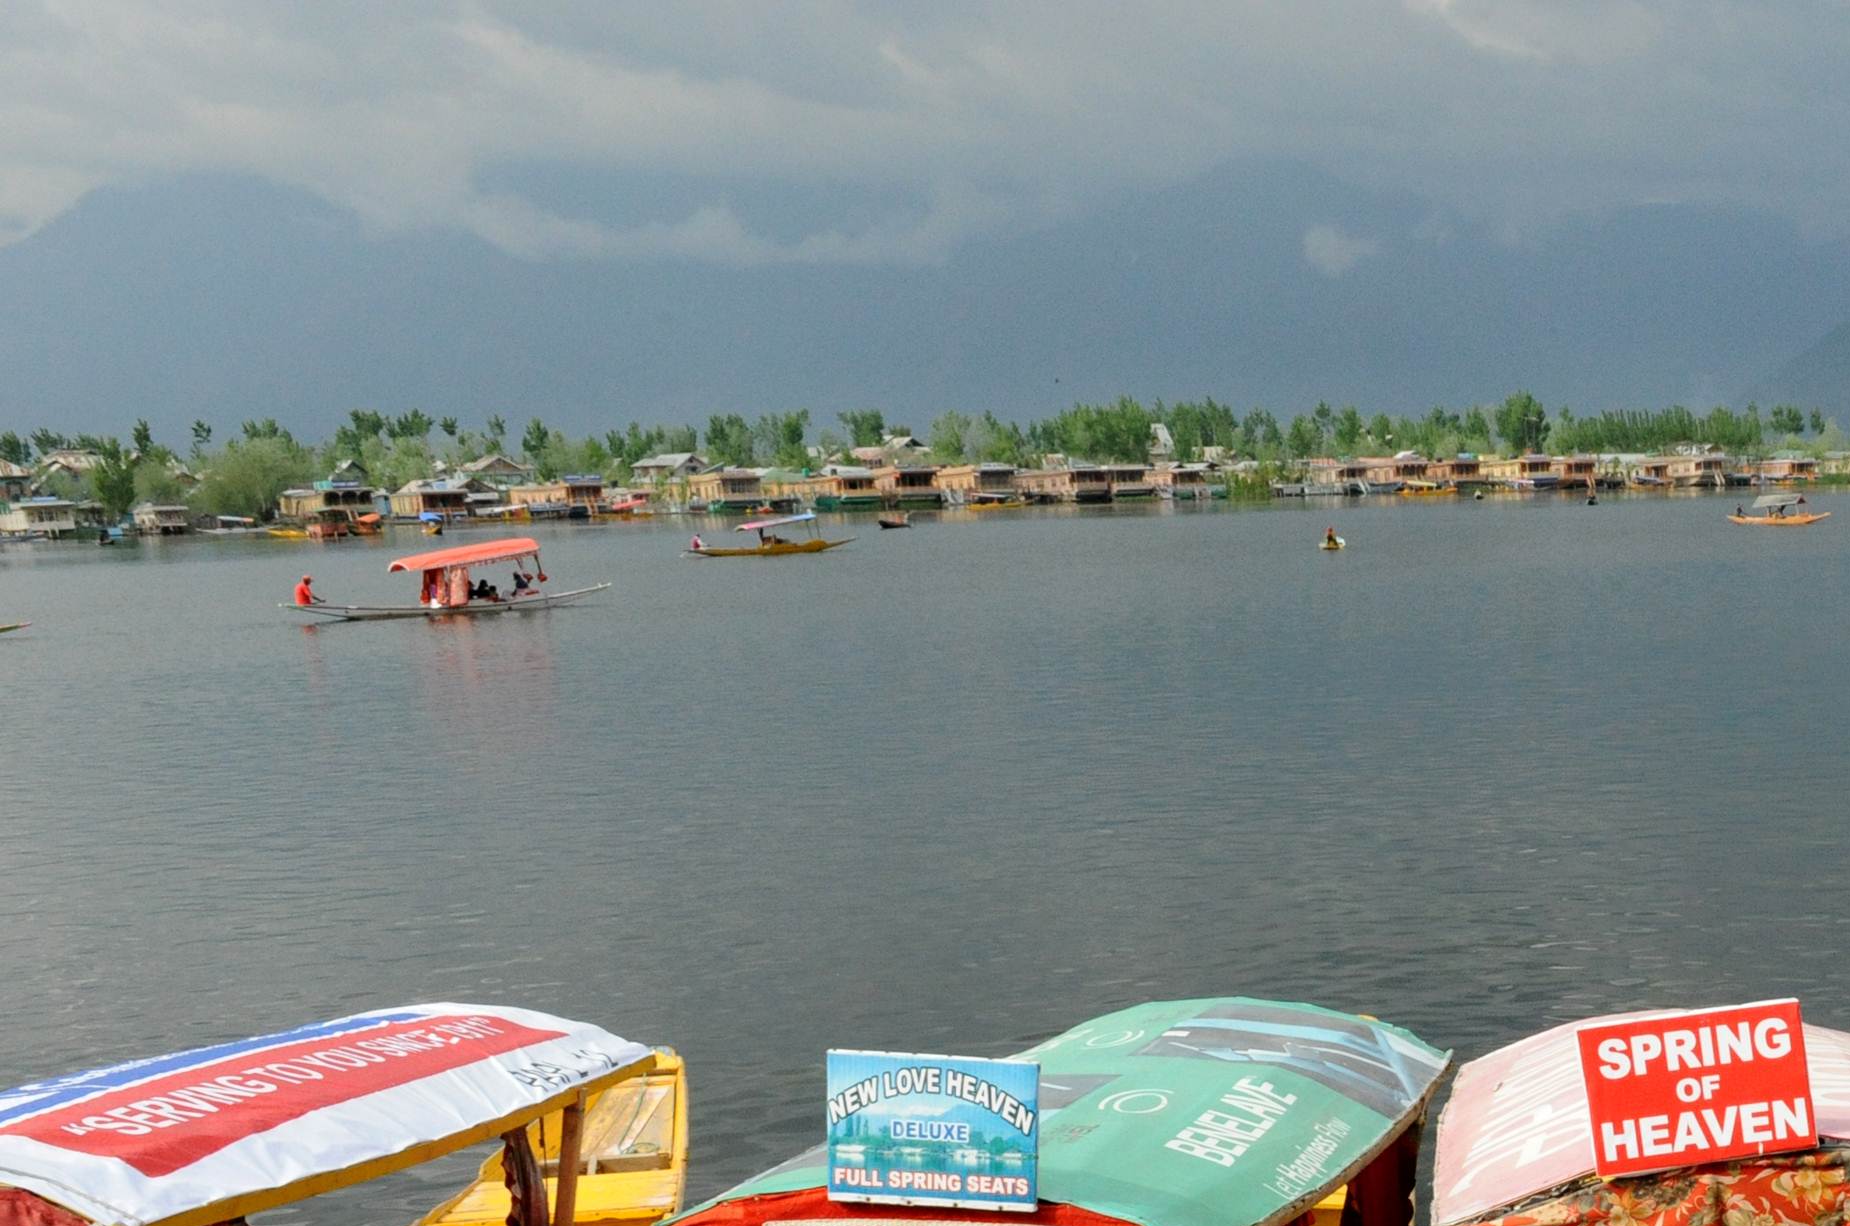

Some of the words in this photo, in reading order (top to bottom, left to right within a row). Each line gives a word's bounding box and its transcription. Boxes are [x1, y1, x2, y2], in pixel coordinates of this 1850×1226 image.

[241, 1063, 324, 1084] TO
[288, 1040, 386, 1072] YOU
[375, 1029, 460, 1058] SINCE
[1597, 1017, 1792, 1080] SPRING
[828, 1075, 879, 1125] NEW
[883, 1067, 941, 1099] LOVE
[946, 1069, 1036, 1136] HEAVEN
[1676, 1074, 1721, 1103] OF
[892, 1121, 969, 1141] DELUXE
[1164, 1076, 1298, 1168] BENELAVE
[1600, 1097, 1810, 1162] HEAVEN
[834, 1168, 883, 1188] FULL
[889, 1171, 962, 1191] SPRING
[966, 1176, 1028, 1195] SEATS
[1275, 1134, 1339, 1187] Happiness
[1262, 1175, 1303, 1201] Let
